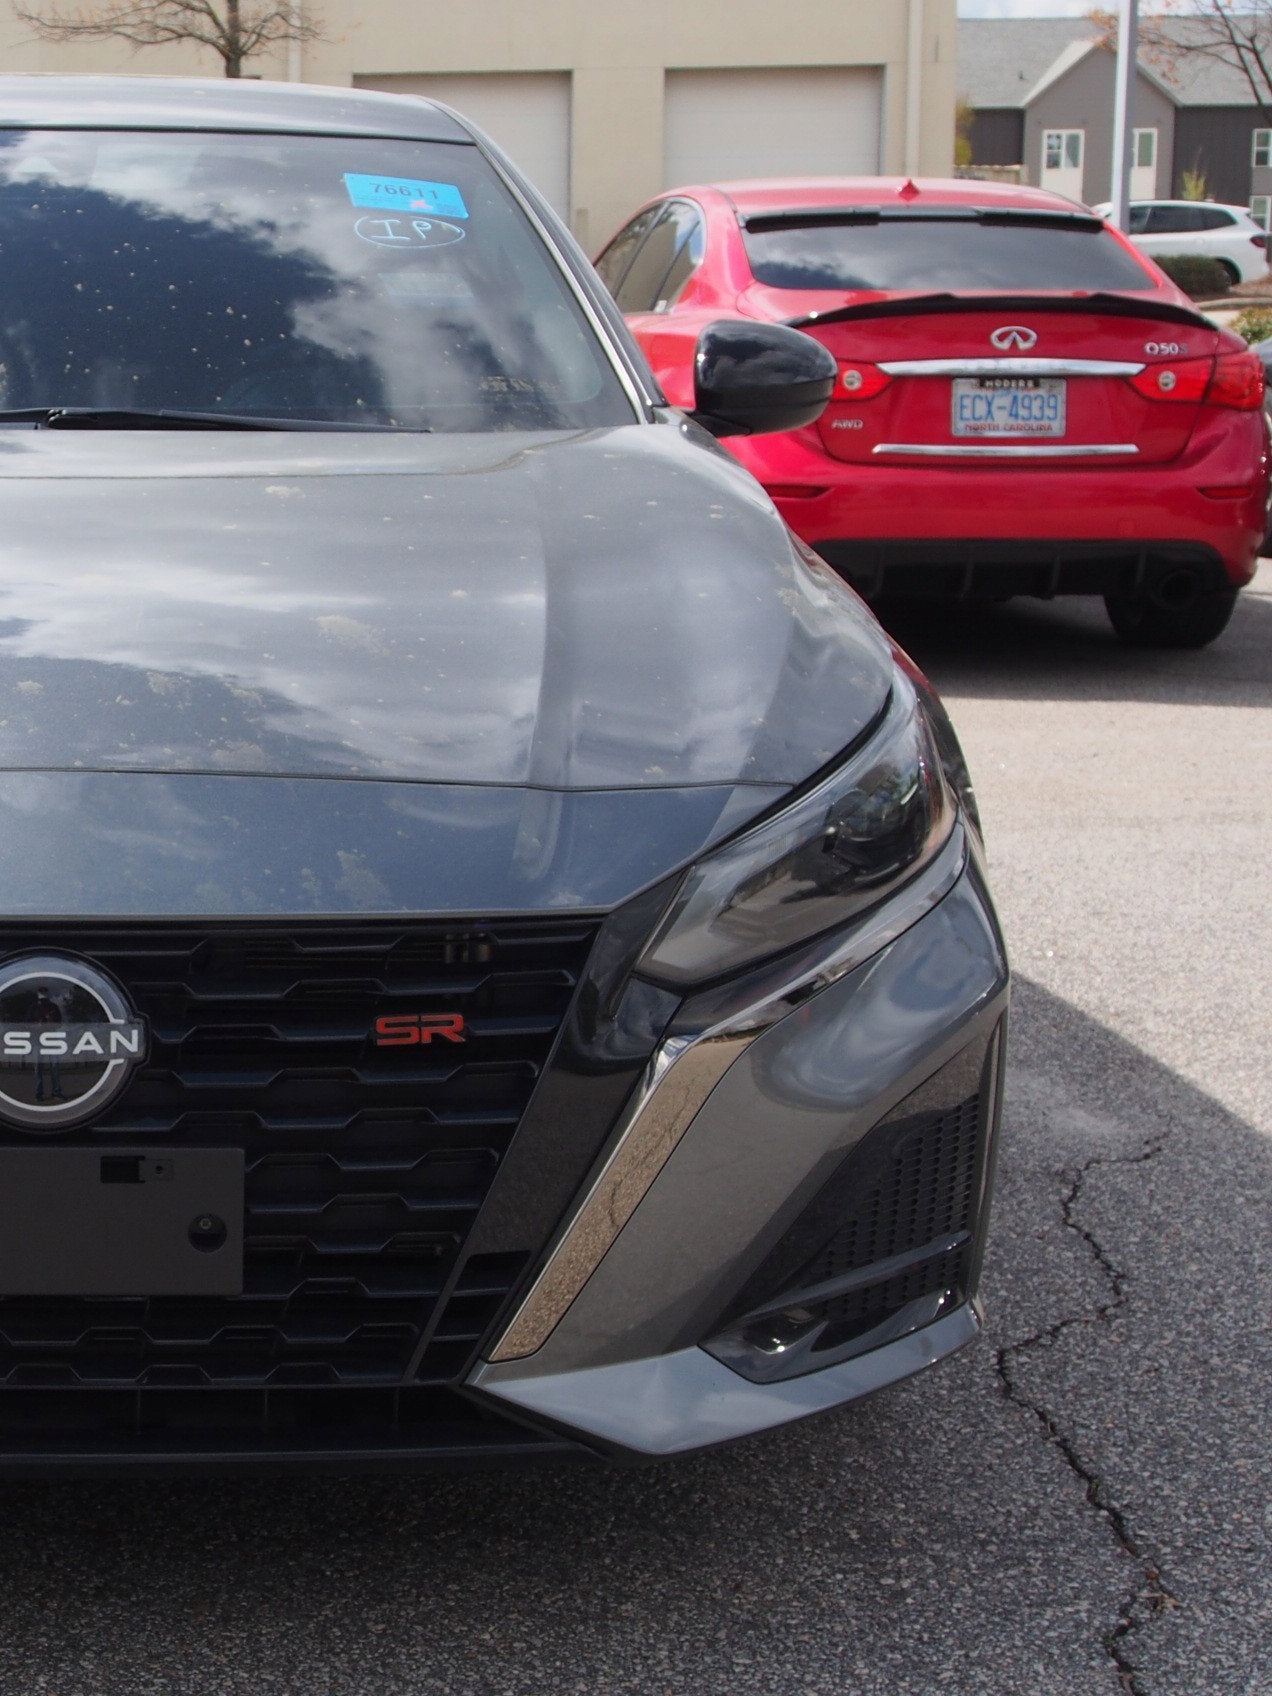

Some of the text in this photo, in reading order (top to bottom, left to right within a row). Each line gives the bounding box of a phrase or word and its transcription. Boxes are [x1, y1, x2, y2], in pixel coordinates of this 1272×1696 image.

[369, 183, 438, 200] 76611
[959, 394, 1059, 421] ECX-4939
[831, 419, 864, 430] AWD
[964, 423, 1053, 432] NORTH CAROLINA
[376, 1014, 466, 1046] SR
